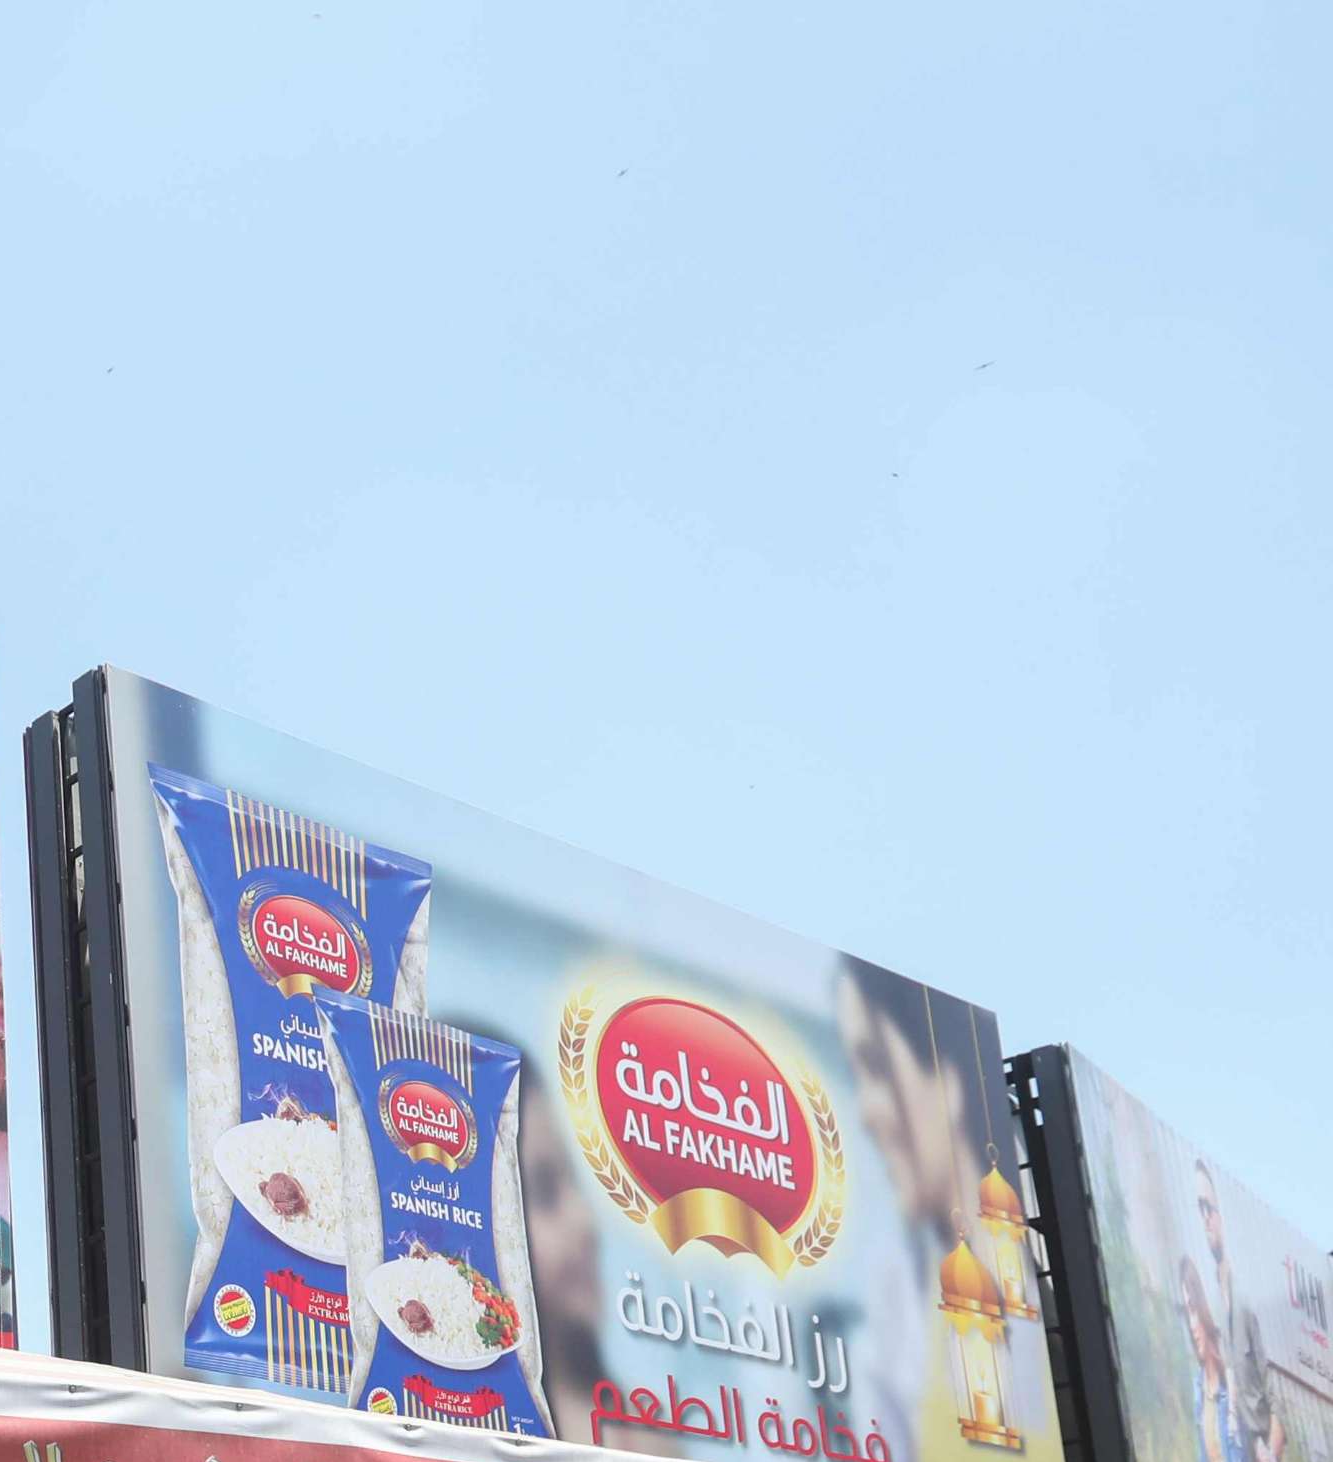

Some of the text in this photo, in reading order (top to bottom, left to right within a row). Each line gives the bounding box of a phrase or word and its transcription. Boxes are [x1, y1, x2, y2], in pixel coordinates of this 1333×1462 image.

[263, 913, 346, 960] الفخامة
[266, 941, 348, 978] AL FAKHAME
[280, 1014, 322, 1040] سباني
[396, 1096, 458, 1129] الفخامة
[615, 1040, 789, 1144] الفخامة
[399, 1118, 459, 1144] AL FAKHAME
[623, 1109, 796, 1190] AL FAKHAME
[390, 1191, 483, 1230] SPANISH RICE
[617, 1270, 848, 1393] رز الفخامة
[589, 1374, 745, 1445] الطعم
